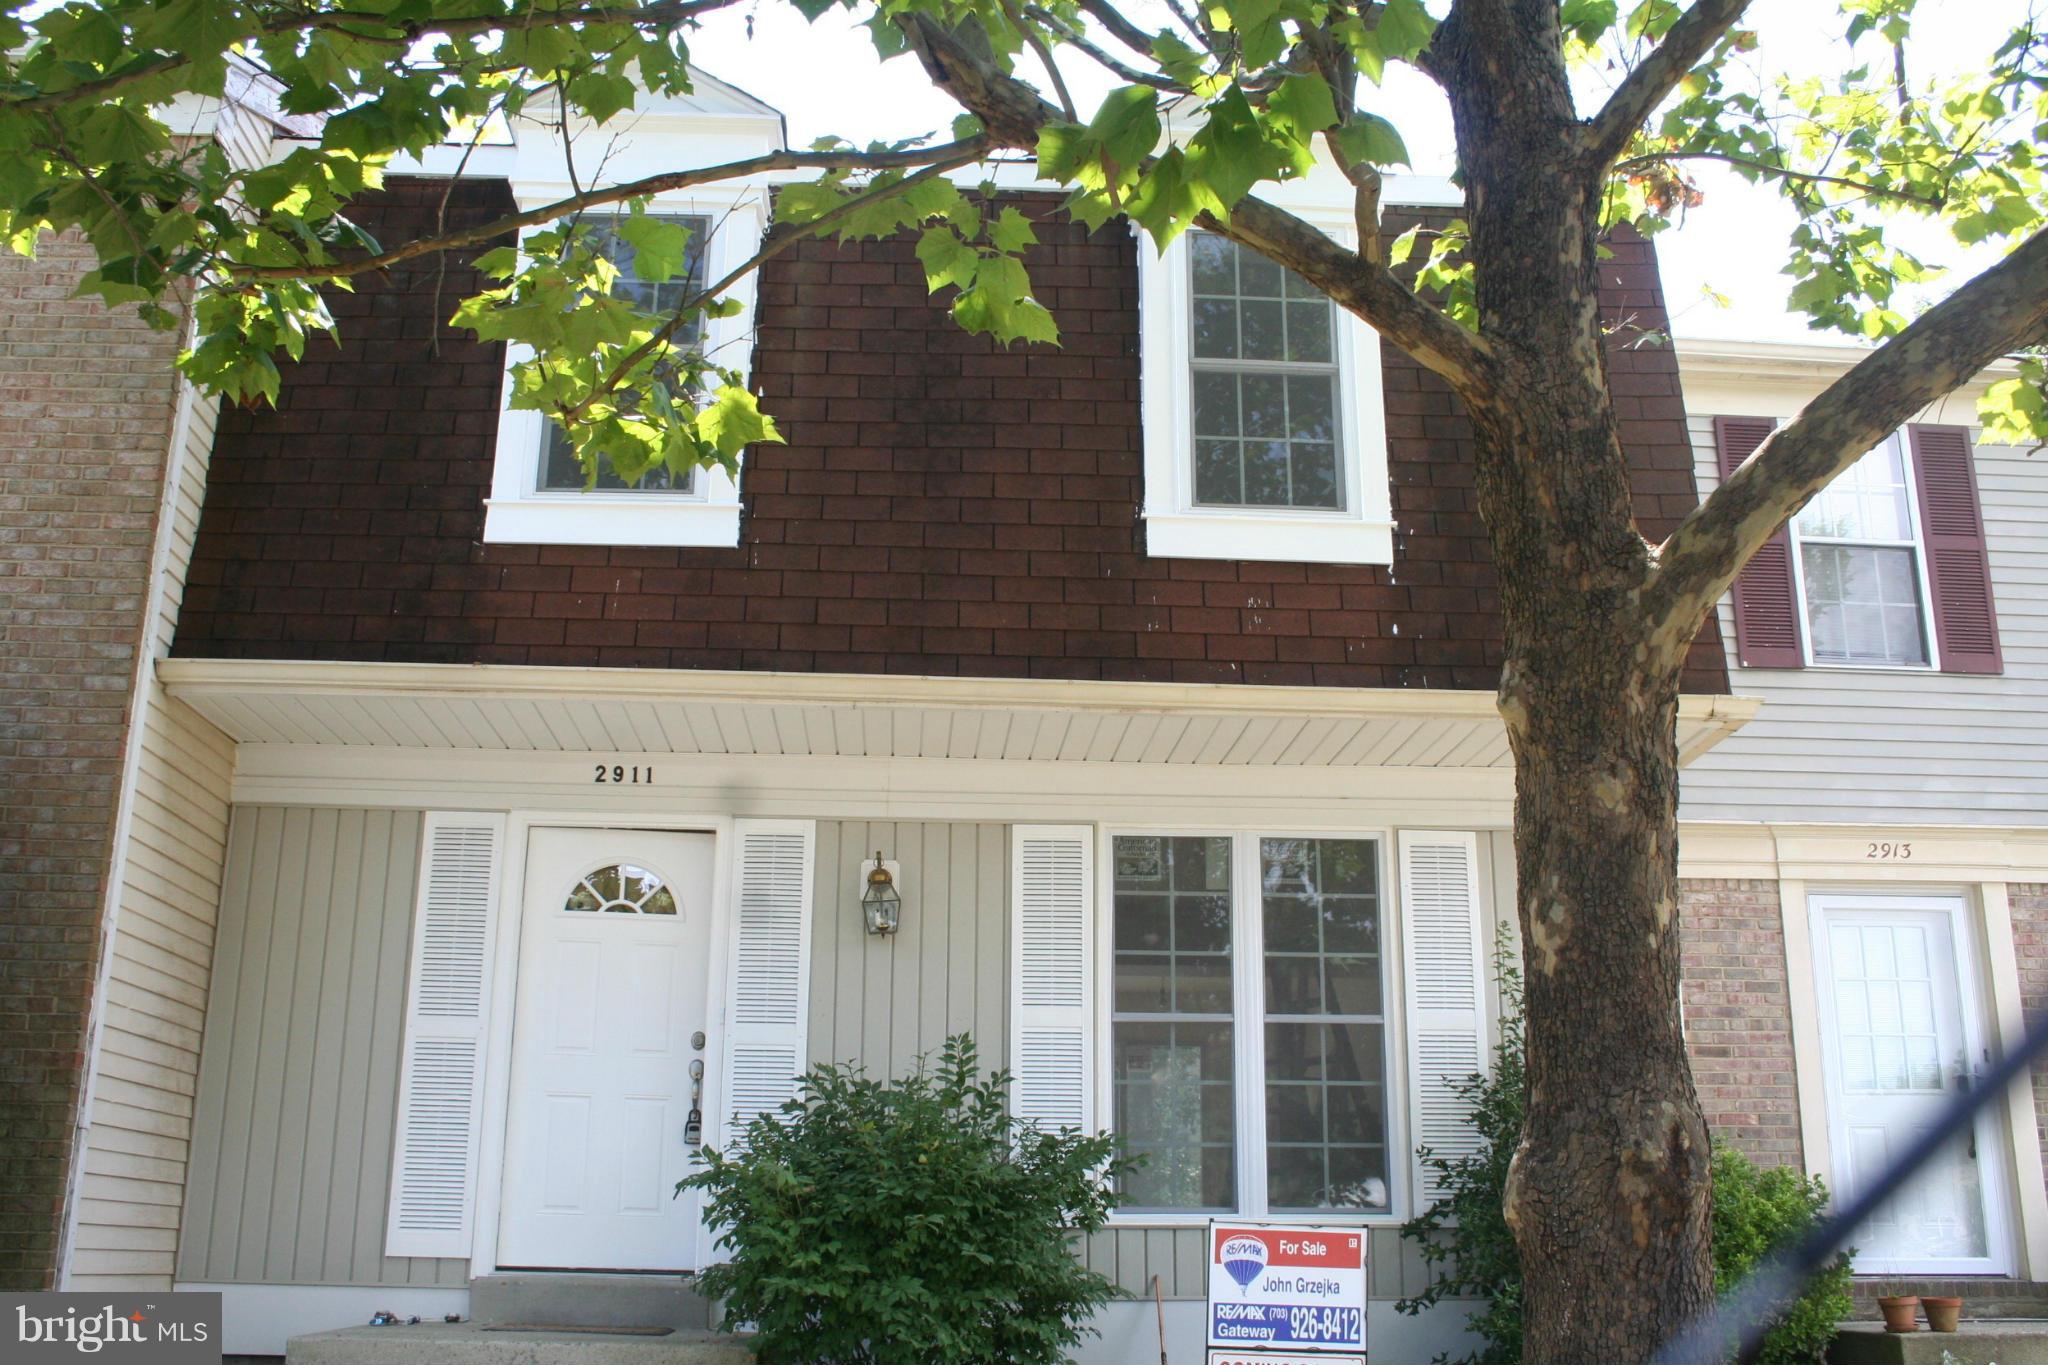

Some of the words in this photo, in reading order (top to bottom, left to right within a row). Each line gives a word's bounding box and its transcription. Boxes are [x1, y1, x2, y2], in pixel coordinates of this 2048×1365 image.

[594, 764, 652, 784] 2911
[1866, 842, 1912, 859] 2913
[1225, 1242, 1263, 1257] RE/MAX
[1279, 1239, 1299, 1255] For
[1302, 1241, 1327, 1256] Sale
[1262, 1276, 1292, 1293] John
[1296, 1277, 1341, 1298] Grzejka
[1216, 1304, 1266, 1321] RE/MAX
[1269, 1307, 1288, 1320] (703)
[1290, 1306, 1360, 1341] 926-8412
[1217, 1322, 1276, 1341] Gateway
